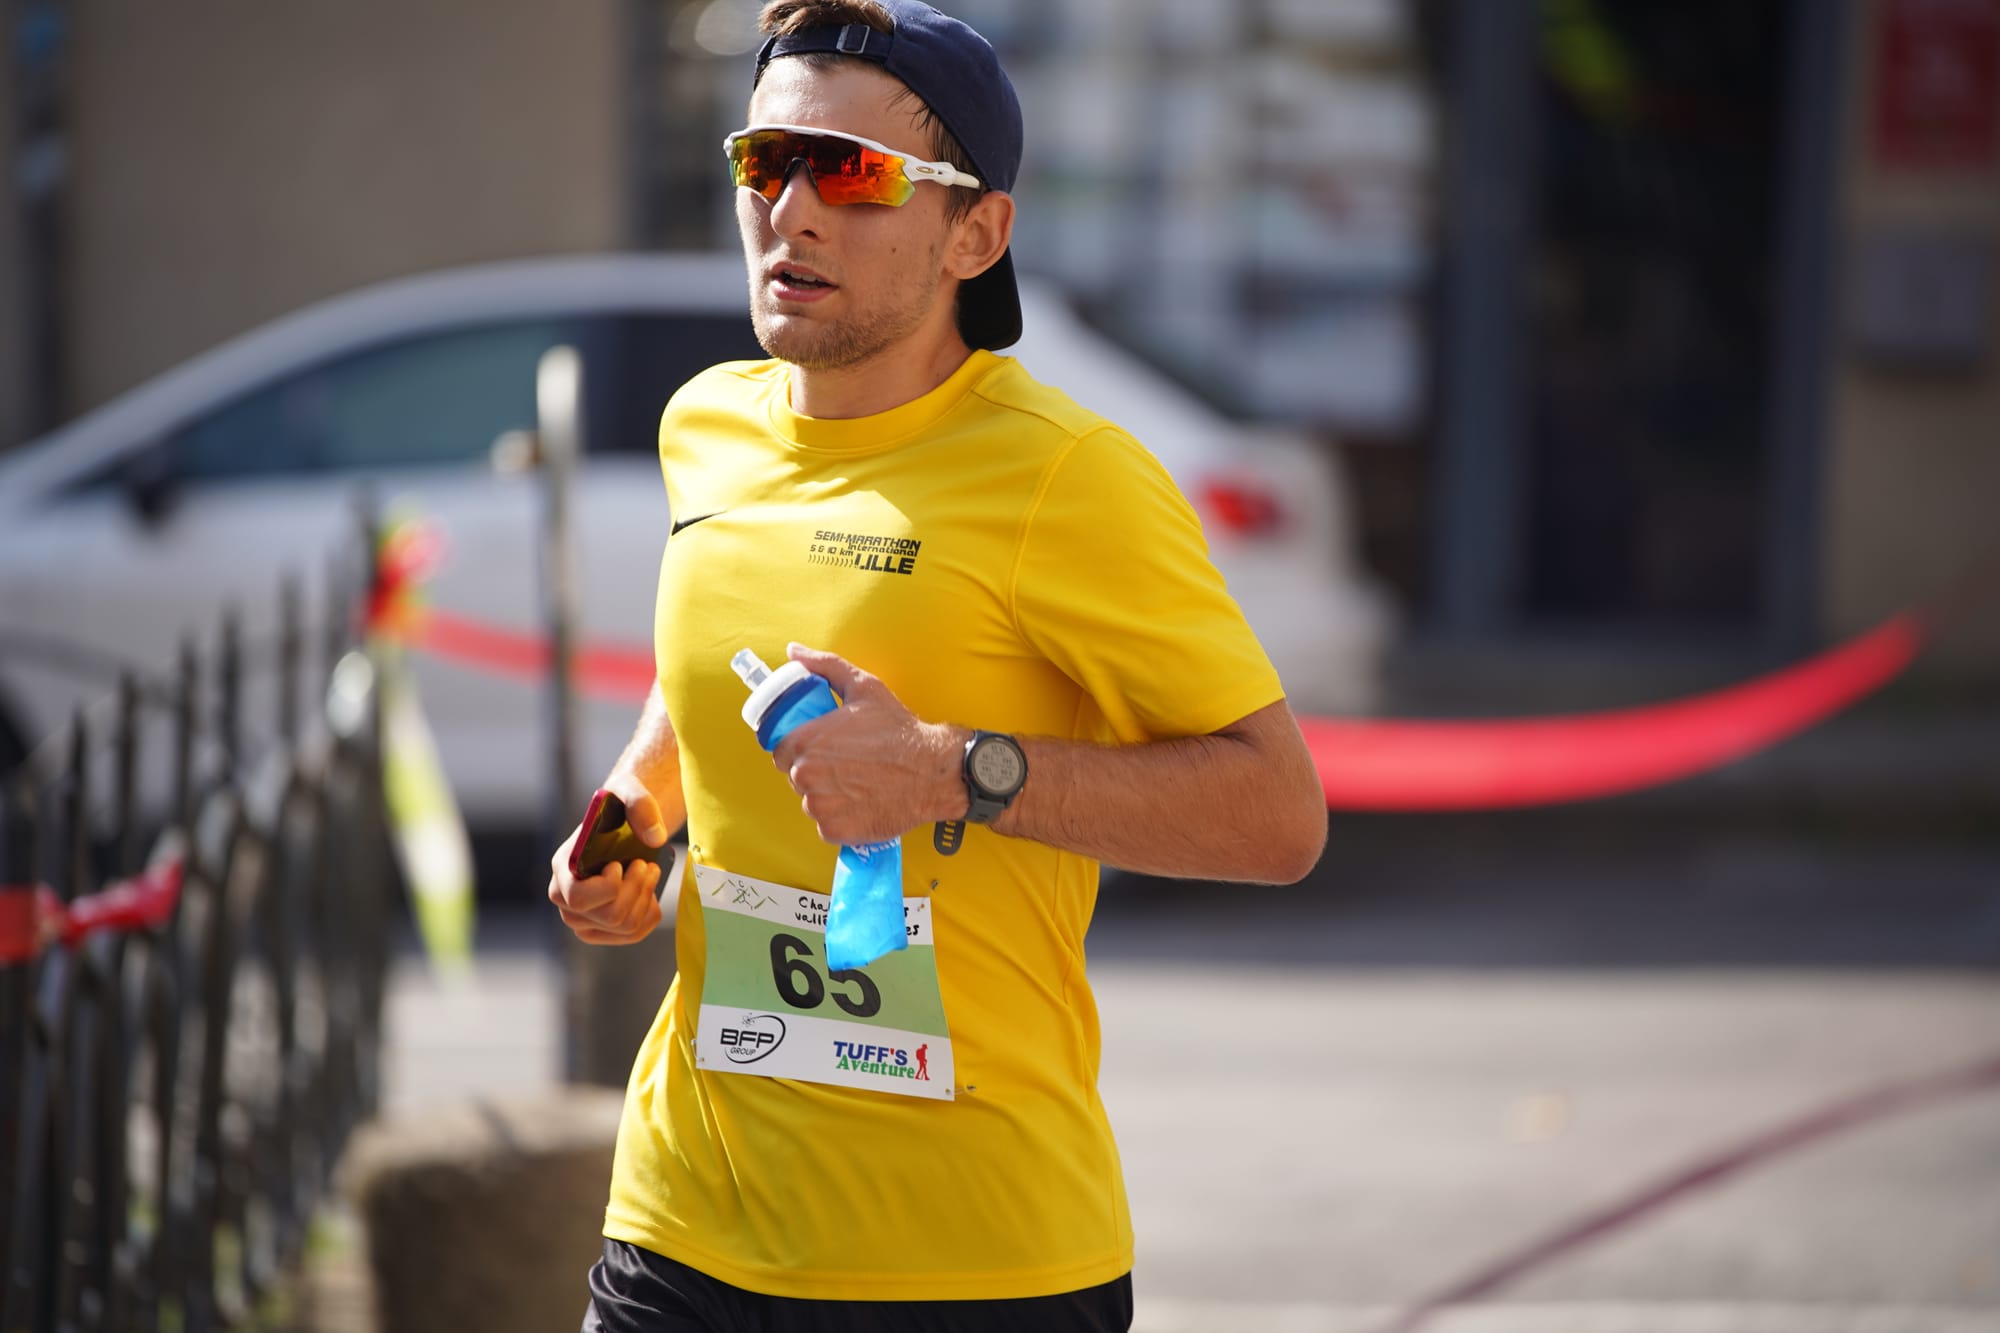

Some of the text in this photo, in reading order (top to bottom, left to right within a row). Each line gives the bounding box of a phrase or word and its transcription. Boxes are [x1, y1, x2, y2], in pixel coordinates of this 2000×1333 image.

[814, 530, 921, 549] SEMI-MARATHON
[848, 543, 918, 556] International
[827, 546, 837, 554] 10
[840, 547, 854, 556] km
[854, 553, 915, 575] LILLE
[770, 933, 881, 1018] 65
[720, 1028, 774, 1049] BFP
[730, 1046, 756, 1056] GROUP
[833, 1041, 908, 1066] TUFF'S
[835, 1055, 915, 1079] Aventure
